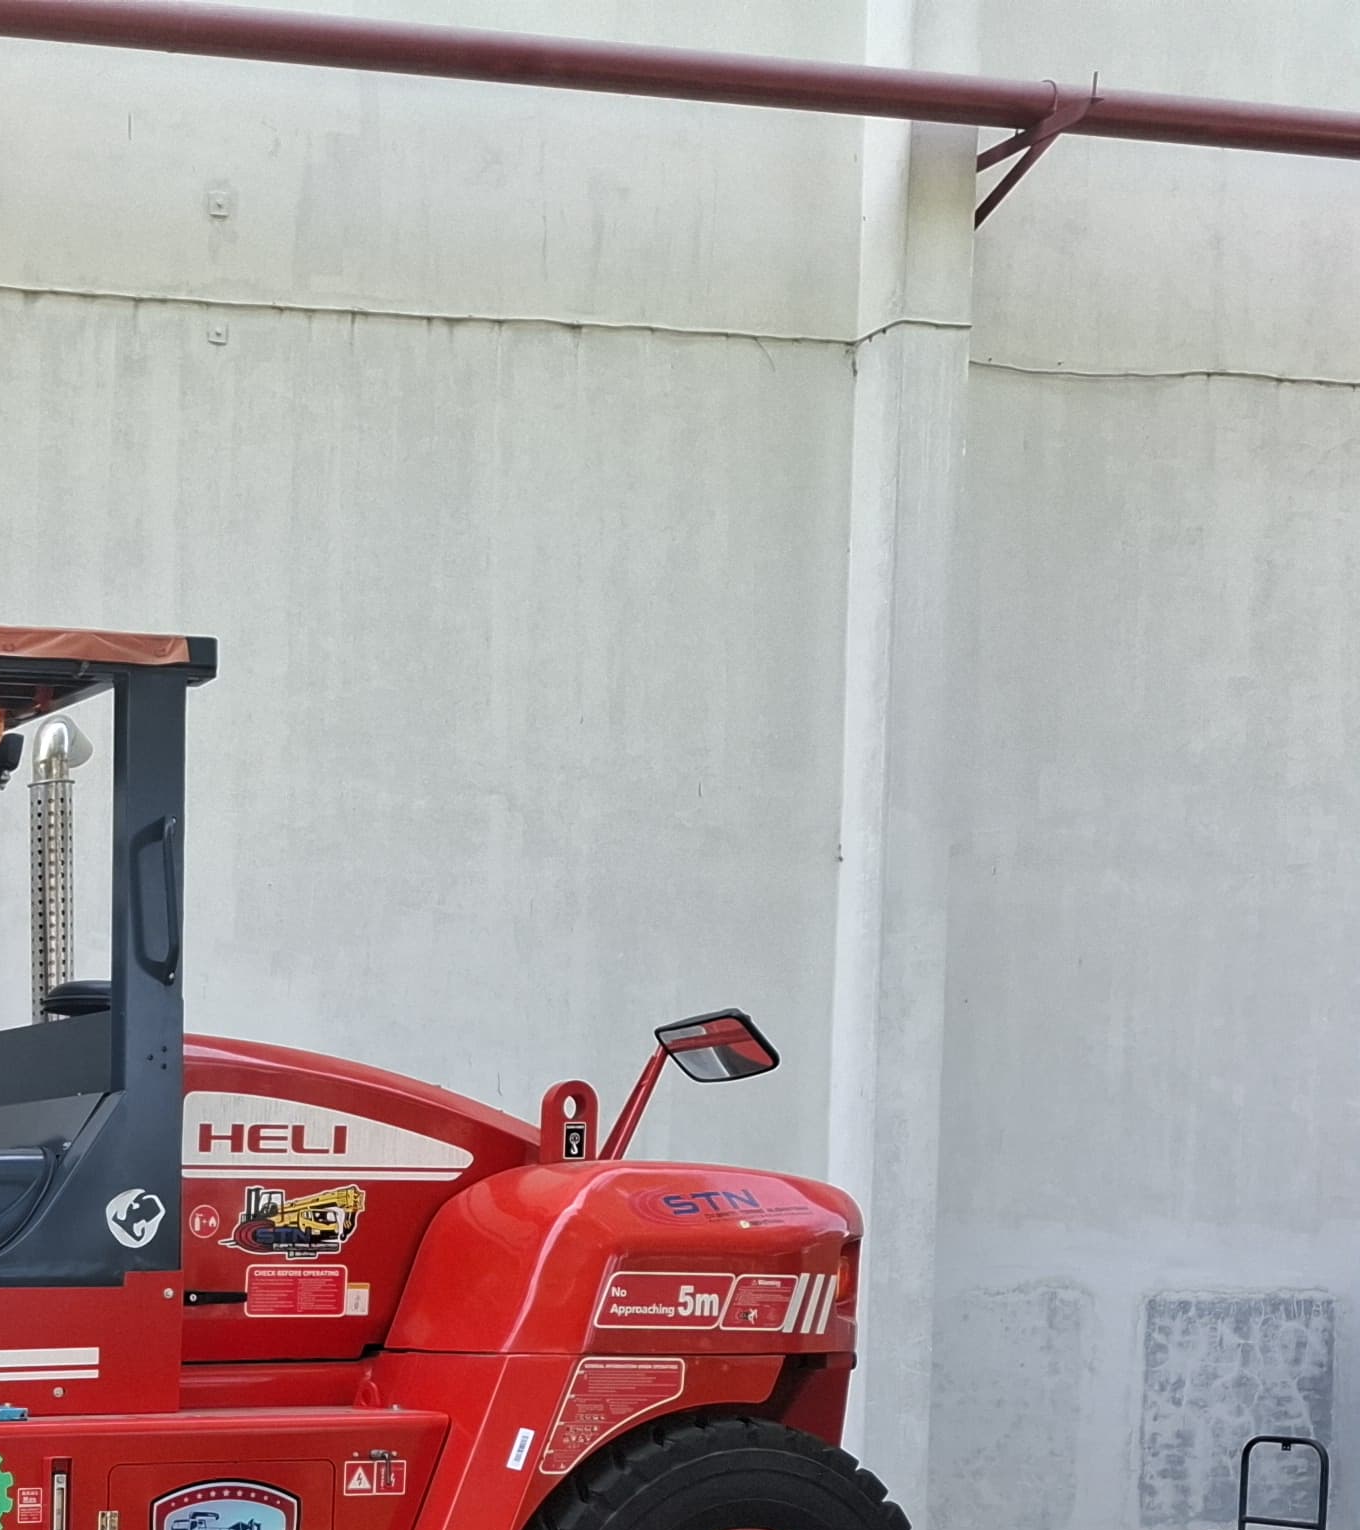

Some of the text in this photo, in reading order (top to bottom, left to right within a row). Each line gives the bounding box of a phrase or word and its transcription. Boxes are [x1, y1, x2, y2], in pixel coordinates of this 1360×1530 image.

[198, 1123, 348, 1155] HELI
[663, 1189, 760, 1216] STN
[610, 1303, 675, 1317] Approaching
[678, 1285, 720, 1317] 5m
[611, 1286, 627, 1298] No
